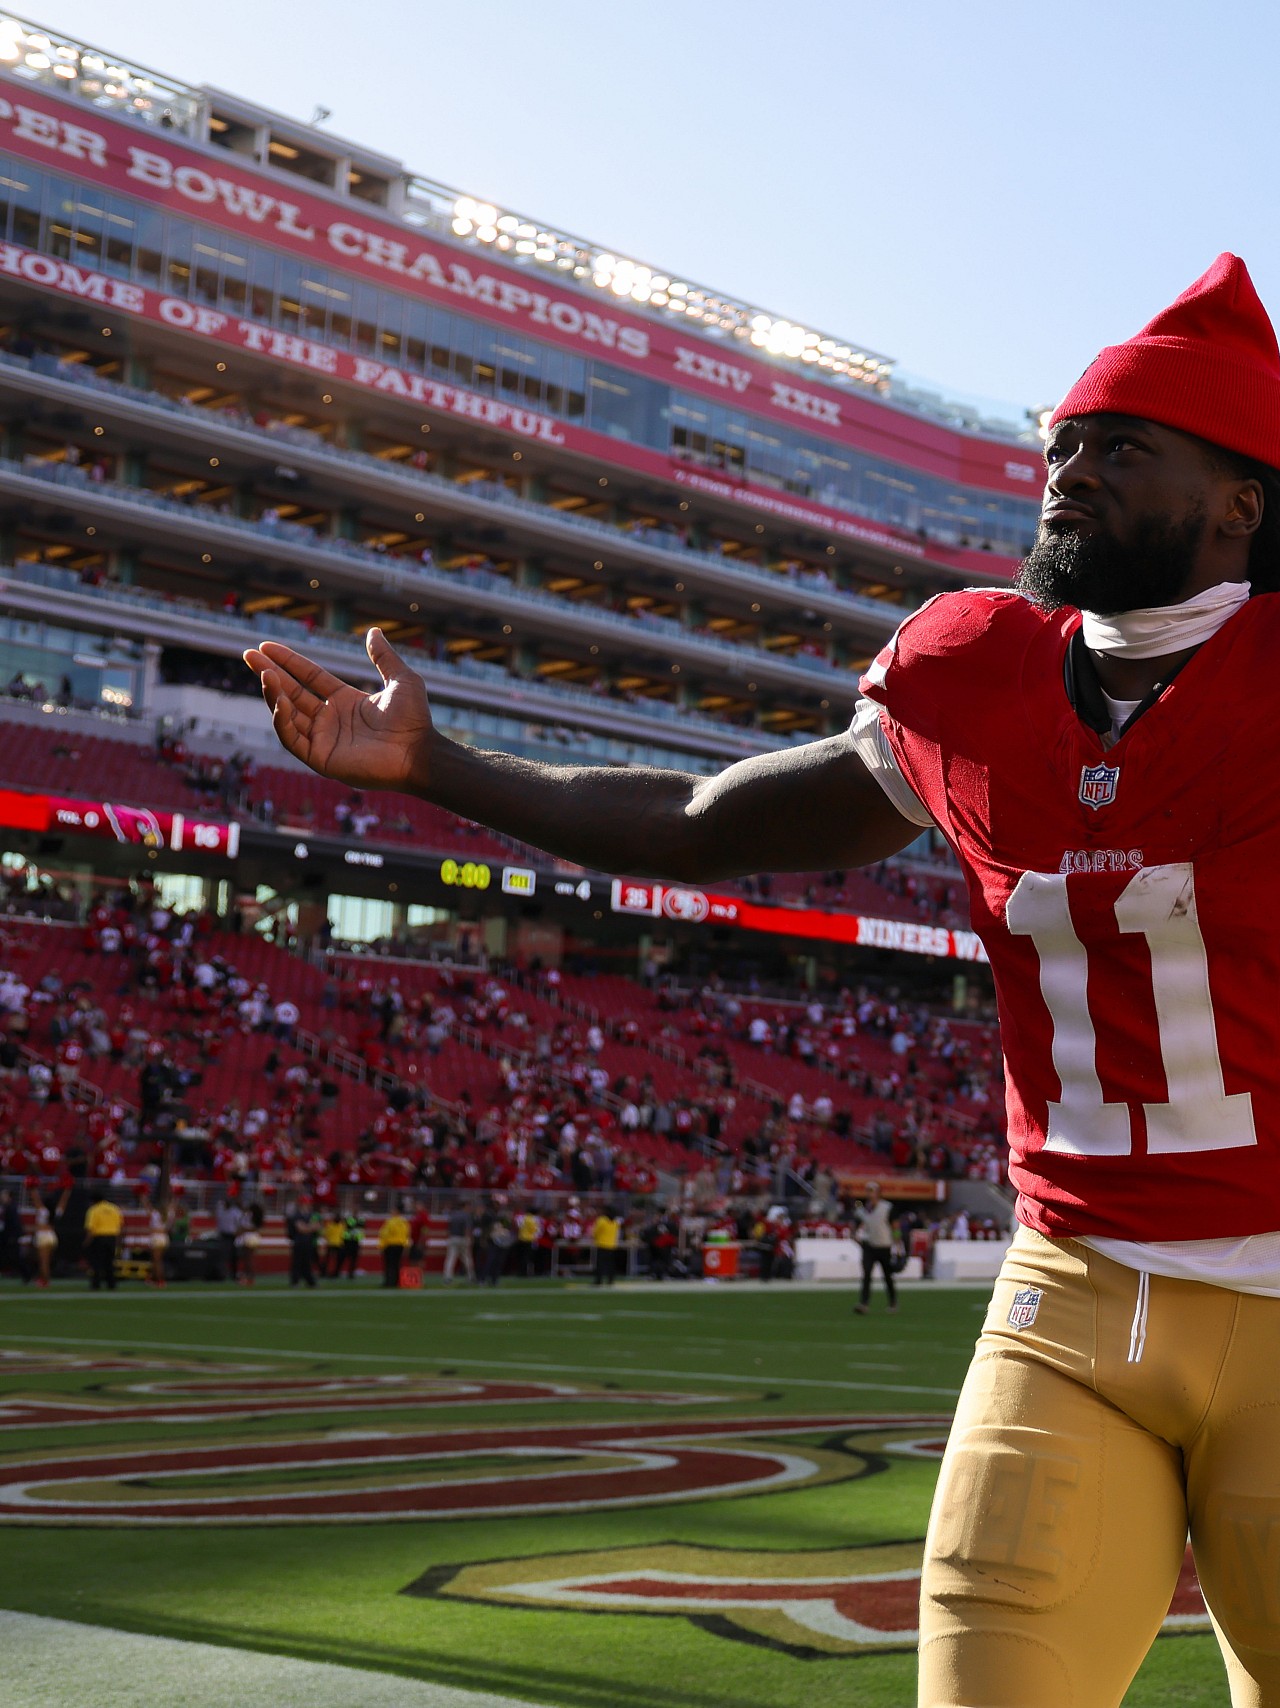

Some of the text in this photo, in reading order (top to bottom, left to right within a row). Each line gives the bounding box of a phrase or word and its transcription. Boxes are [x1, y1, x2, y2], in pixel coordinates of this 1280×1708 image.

[0, 97, 842, 427] ER BOWL CHAMPIONS XXIV XXIX
[159, 299, 228, 337] OF
[238, 322, 337, 373] THE
[353, 356, 564, 445] FAITHFUL
[1085, 781, 1111, 801] NFL
[193, 823, 220, 848] 16
[440, 858, 491, 891] 0:00
[1059, 848, 1144, 875] 49ERS
[856, 916, 949, 957] NINERS
[1006, 862, 1258, 1156] 11
[1011, 1304, 1032, 1324] NFL
